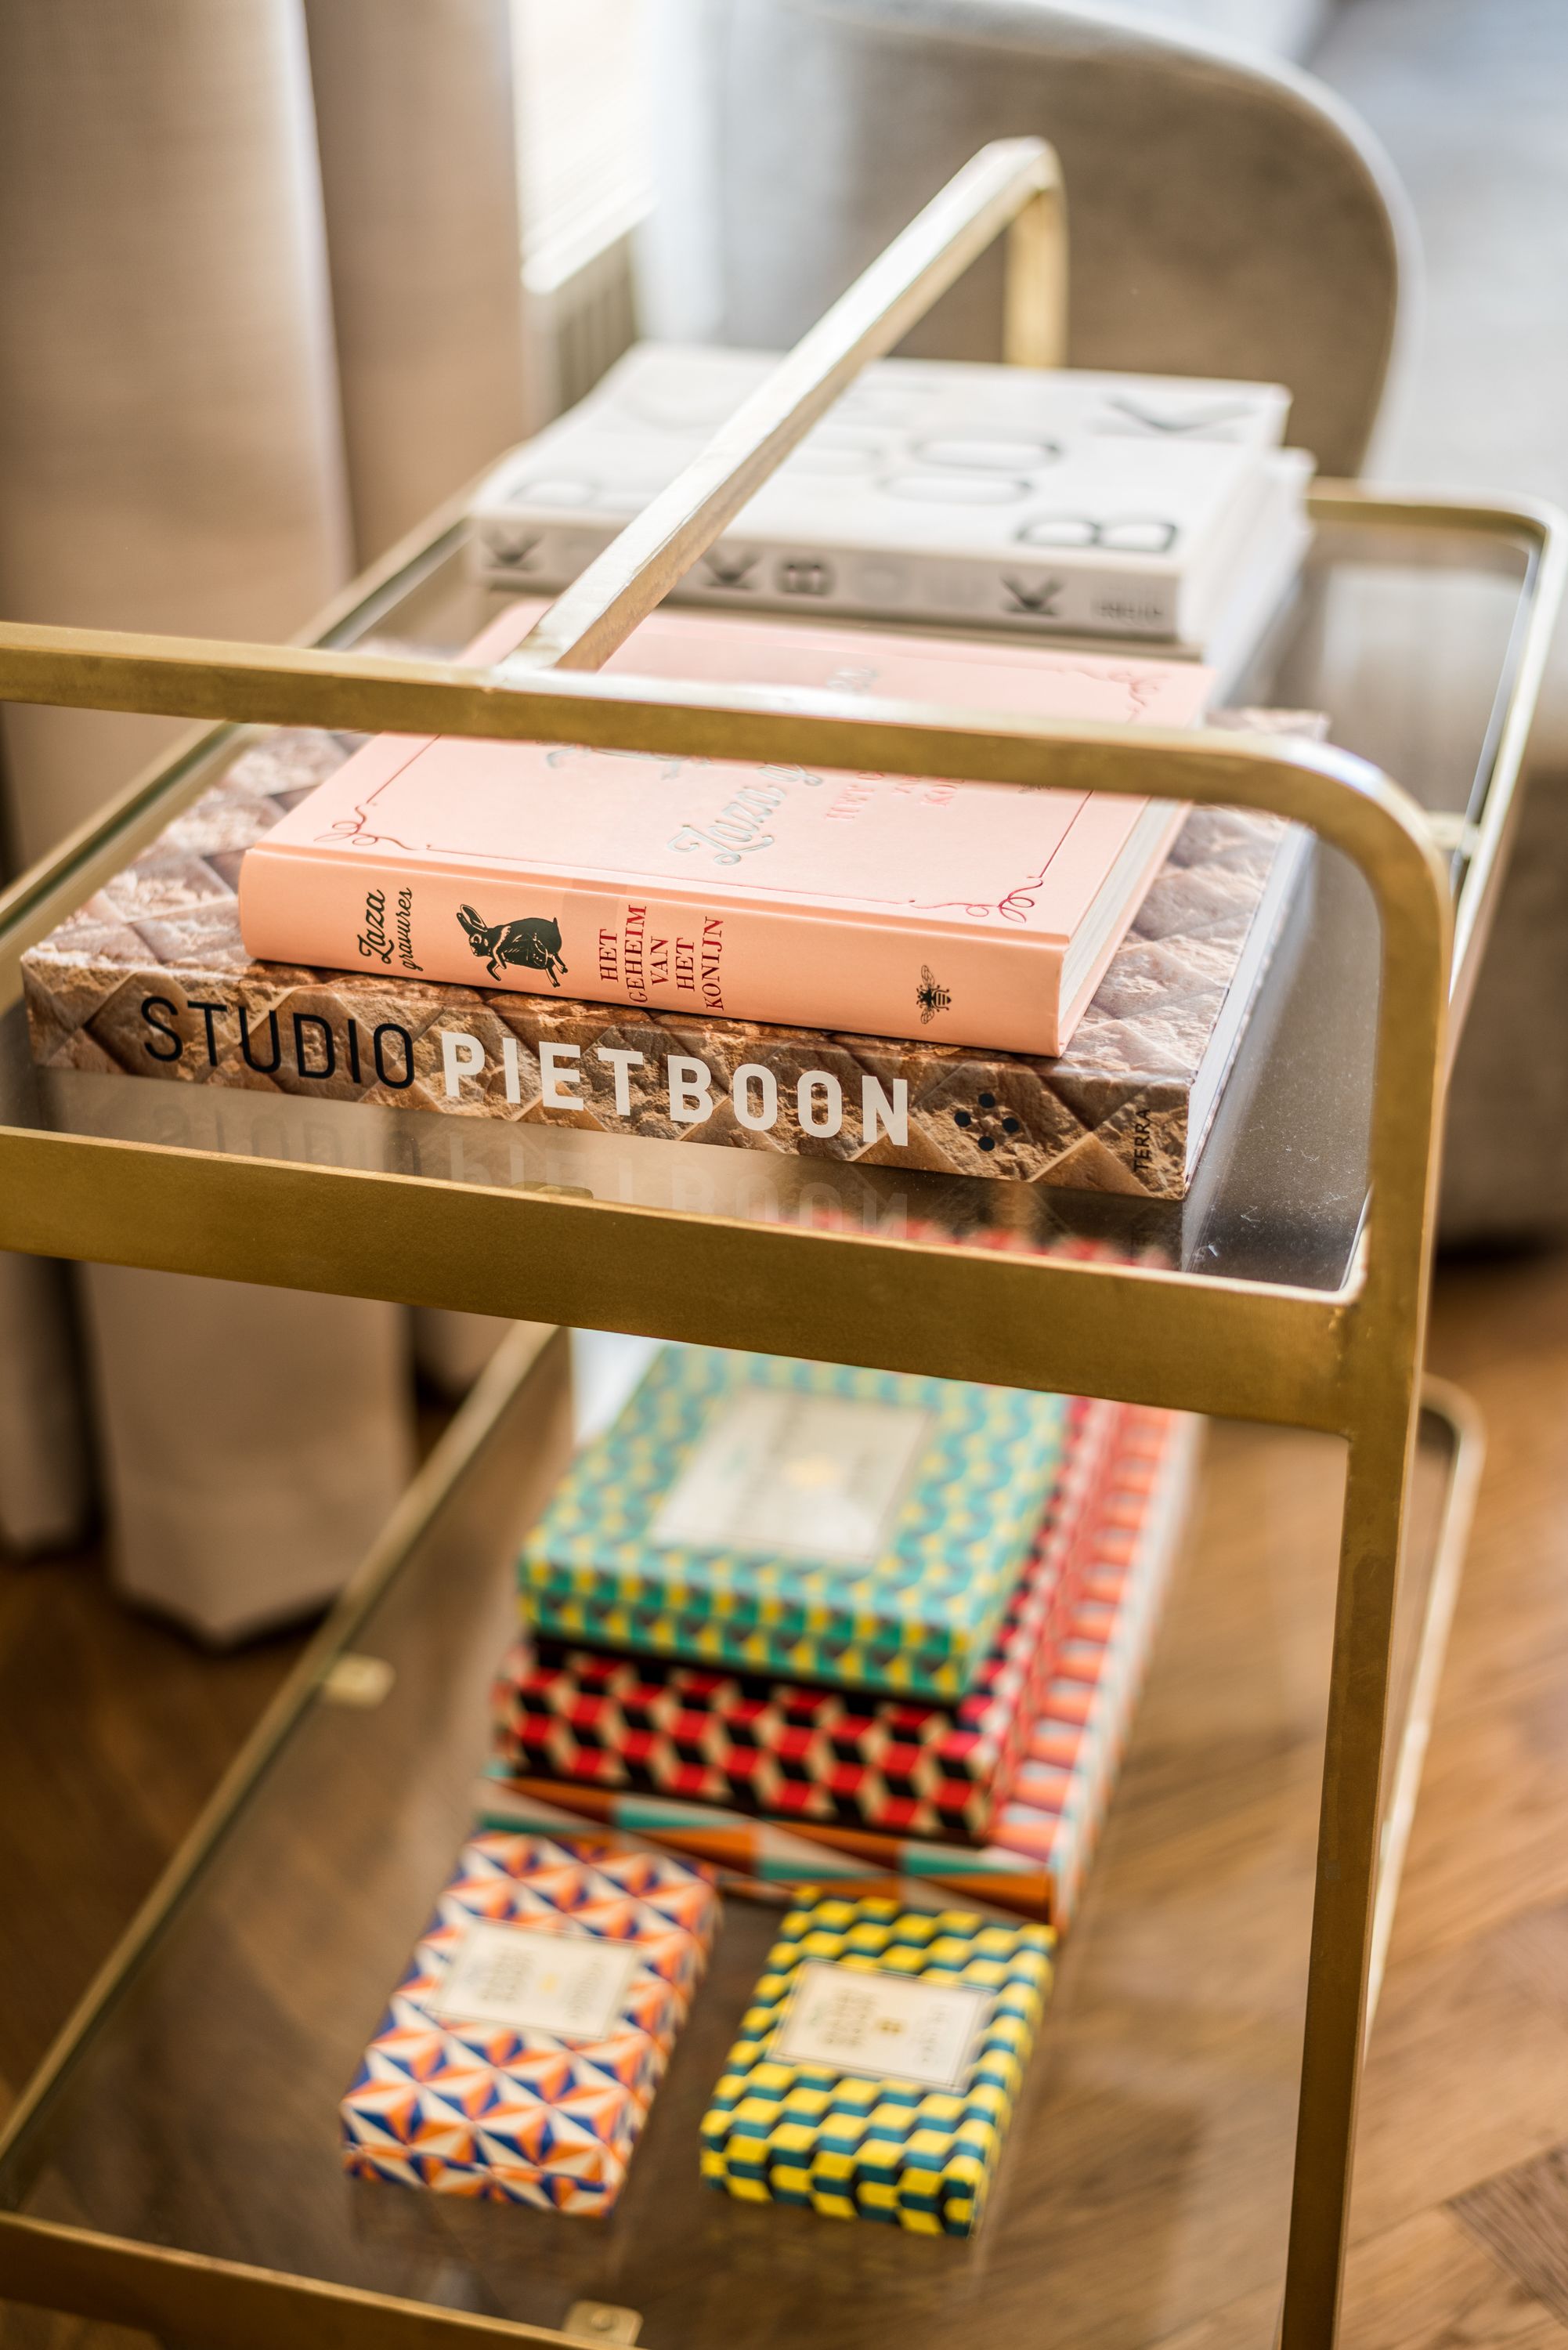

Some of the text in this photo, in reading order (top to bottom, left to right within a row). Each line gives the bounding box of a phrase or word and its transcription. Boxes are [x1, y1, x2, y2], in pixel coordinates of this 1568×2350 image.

[667, 785, 786, 866] Zaza
[356, 888, 395, 964] Zaza
[395, 887, 424, 972] gravures
[598, 928, 619, 983] HET
[624, 904, 649, 1003] GEHEIM
[650, 935, 669, 985] VAN
[675, 937, 695, 992] HET
[701, 916, 724, 1011] KONIJN
[140, 996, 415, 1090] STUDIO
[1133, 1108, 1151, 1173] TERRA
